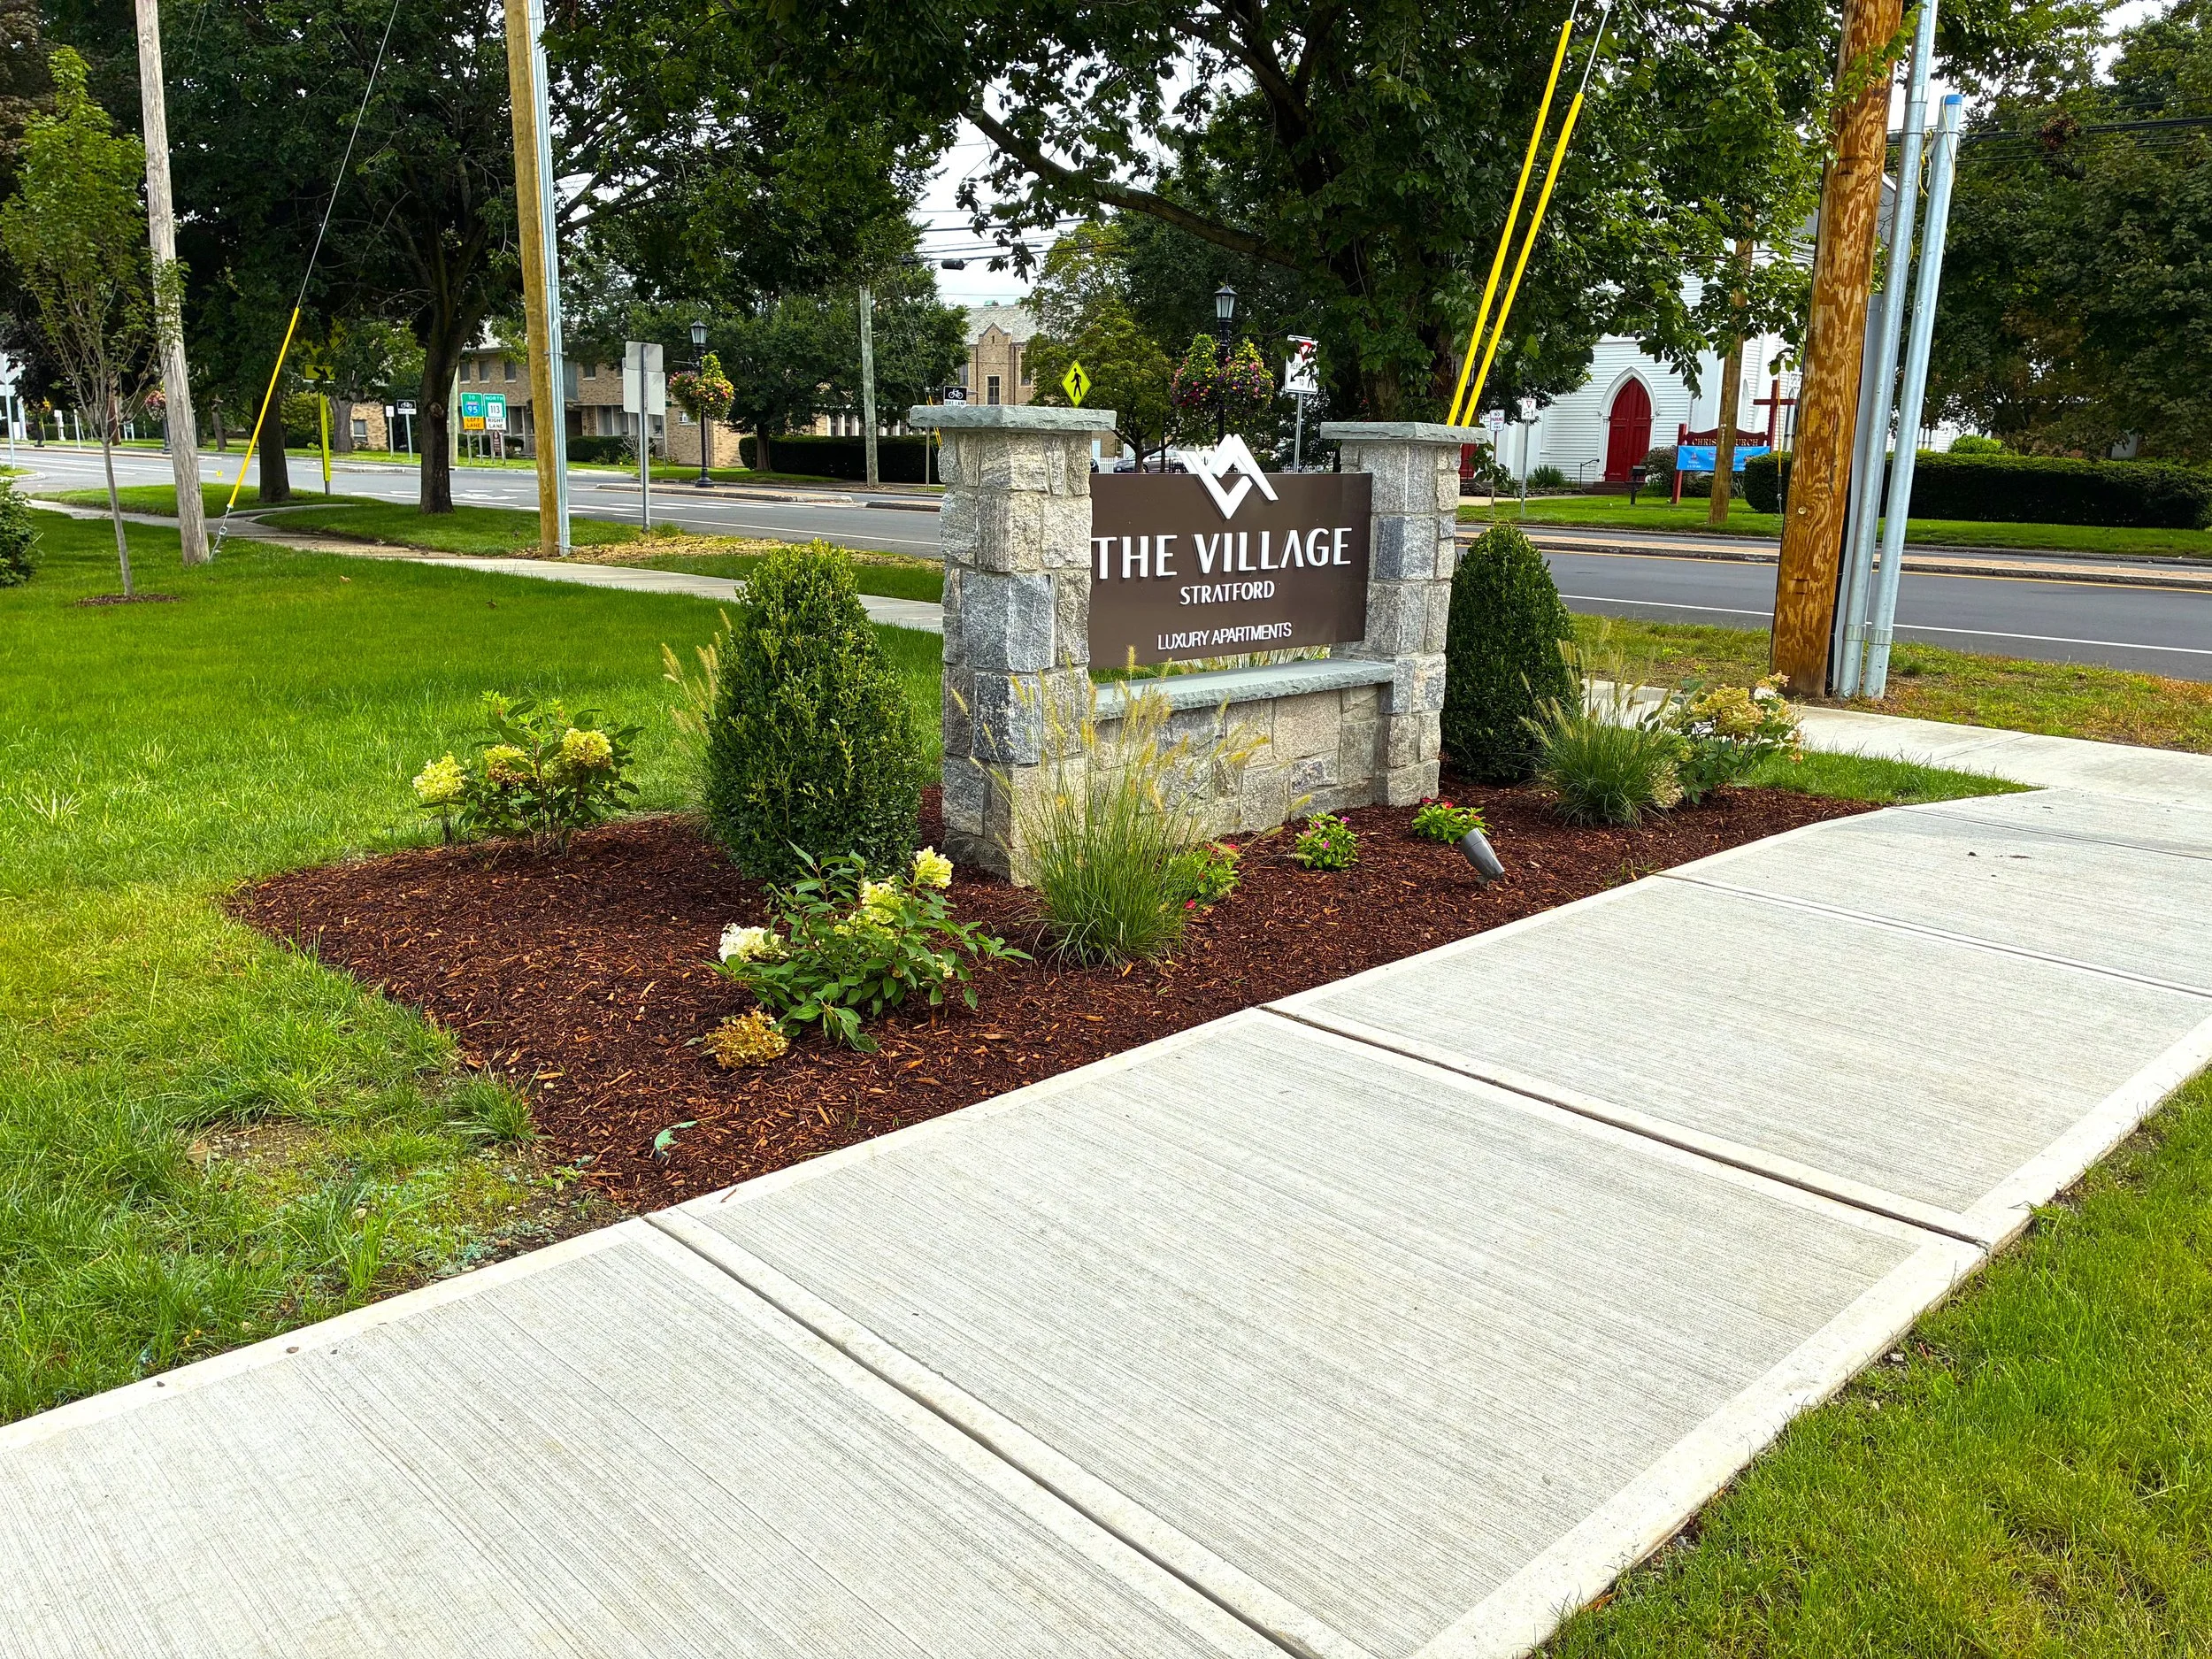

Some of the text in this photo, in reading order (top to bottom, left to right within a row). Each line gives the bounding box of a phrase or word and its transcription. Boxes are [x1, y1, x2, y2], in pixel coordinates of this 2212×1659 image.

[490, 405, 501, 414] 113
[1091, 528, 1353, 580] THE VILLAGE
[1179, 580, 1275, 605] STRATFORD
[1157, 622, 1292, 650] LUXURY APARTMENTS
